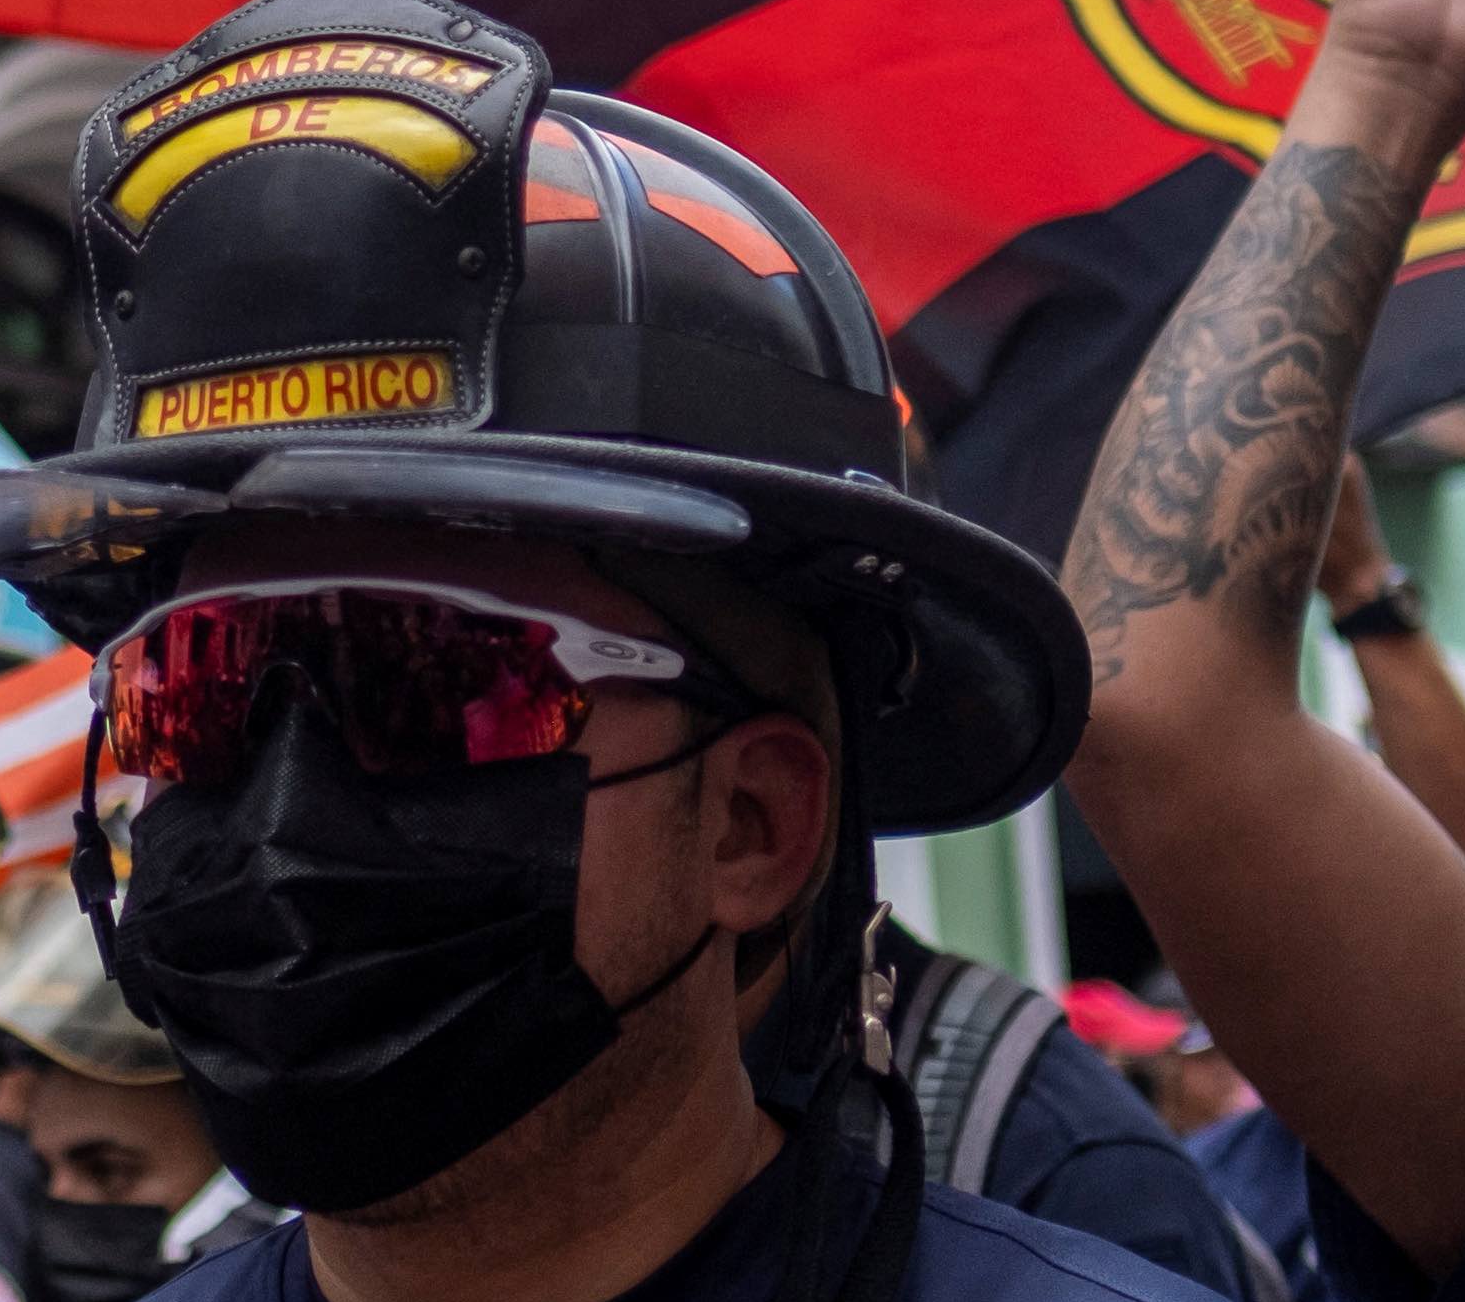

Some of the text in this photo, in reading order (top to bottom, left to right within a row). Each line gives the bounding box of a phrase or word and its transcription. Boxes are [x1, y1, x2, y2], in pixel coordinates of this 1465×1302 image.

[151, 43, 475, 124] BOMBEROS
[247, 98, 341, 140] DE
[158, 358, 438, 435] PUERTO RICO
